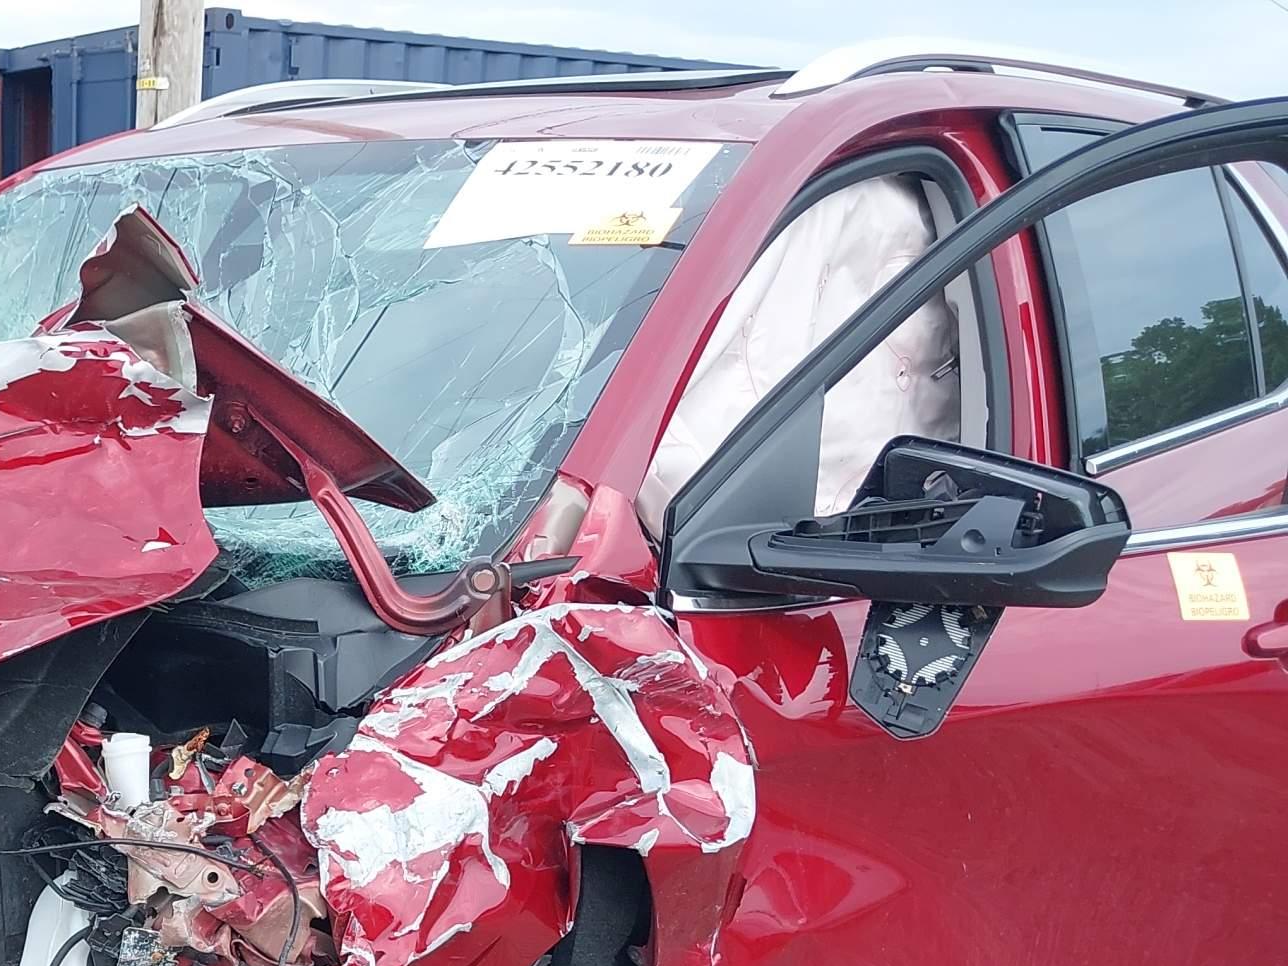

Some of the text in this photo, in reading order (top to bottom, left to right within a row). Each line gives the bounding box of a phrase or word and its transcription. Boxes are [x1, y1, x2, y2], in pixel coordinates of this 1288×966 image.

[494, 159, 674, 178] 42552180
[1188, 592, 1237, 602] BIOHAZARD
[1191, 607, 1240, 616] BIOPELIGRO
